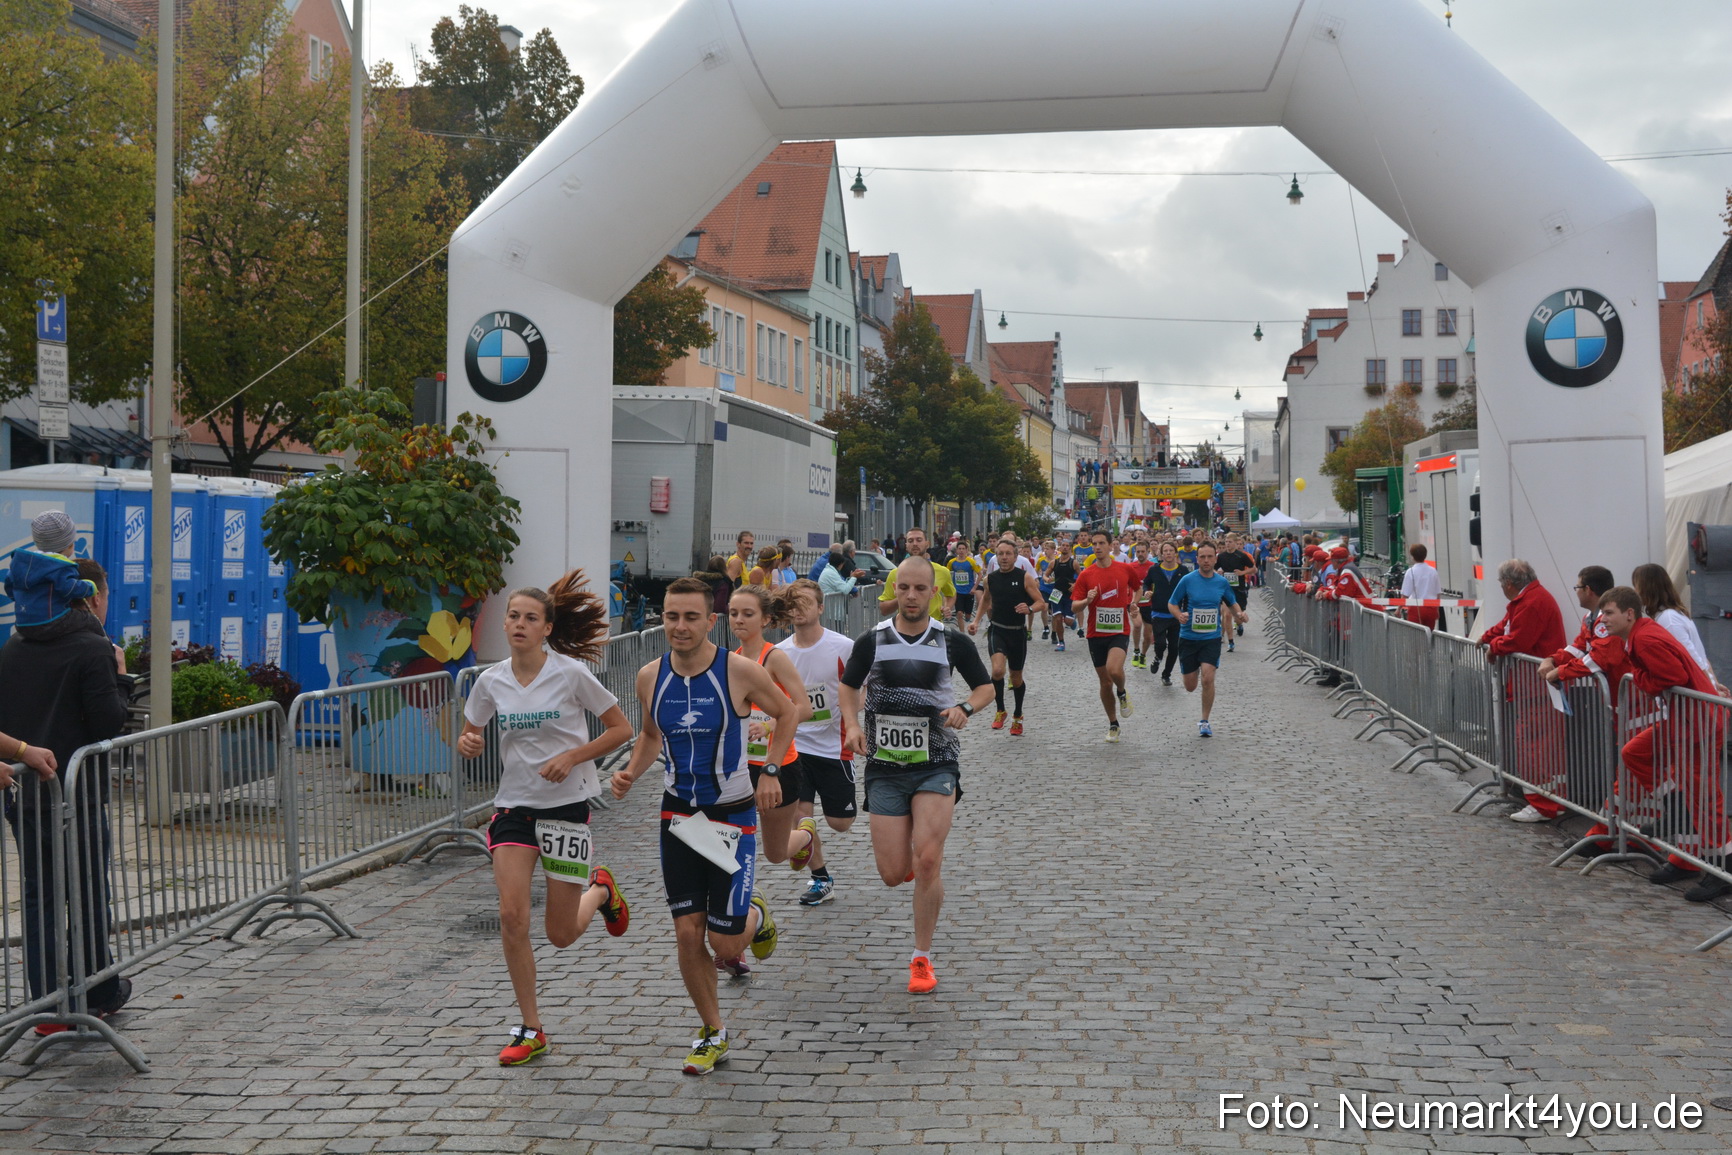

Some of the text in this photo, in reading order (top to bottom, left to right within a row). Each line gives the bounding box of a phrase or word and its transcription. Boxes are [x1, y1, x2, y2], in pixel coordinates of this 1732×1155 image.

[44, 291, 59, 333] P
[1533, 290, 1616, 324] BMW
[470, 313, 541, 343] BMW
[1145, 488, 1178, 496] START
[224, 514, 245, 539] DIXI
[1098, 613, 1121, 623] 5085
[1195, 614, 1216, 623] 5078
[509, 711, 560, 722] RUNNERS
[510, 721, 541, 730] POINT
[880, 727, 924, 748] 5066
[542, 833, 589, 861] 5150
[550, 861, 579, 874] Samira
